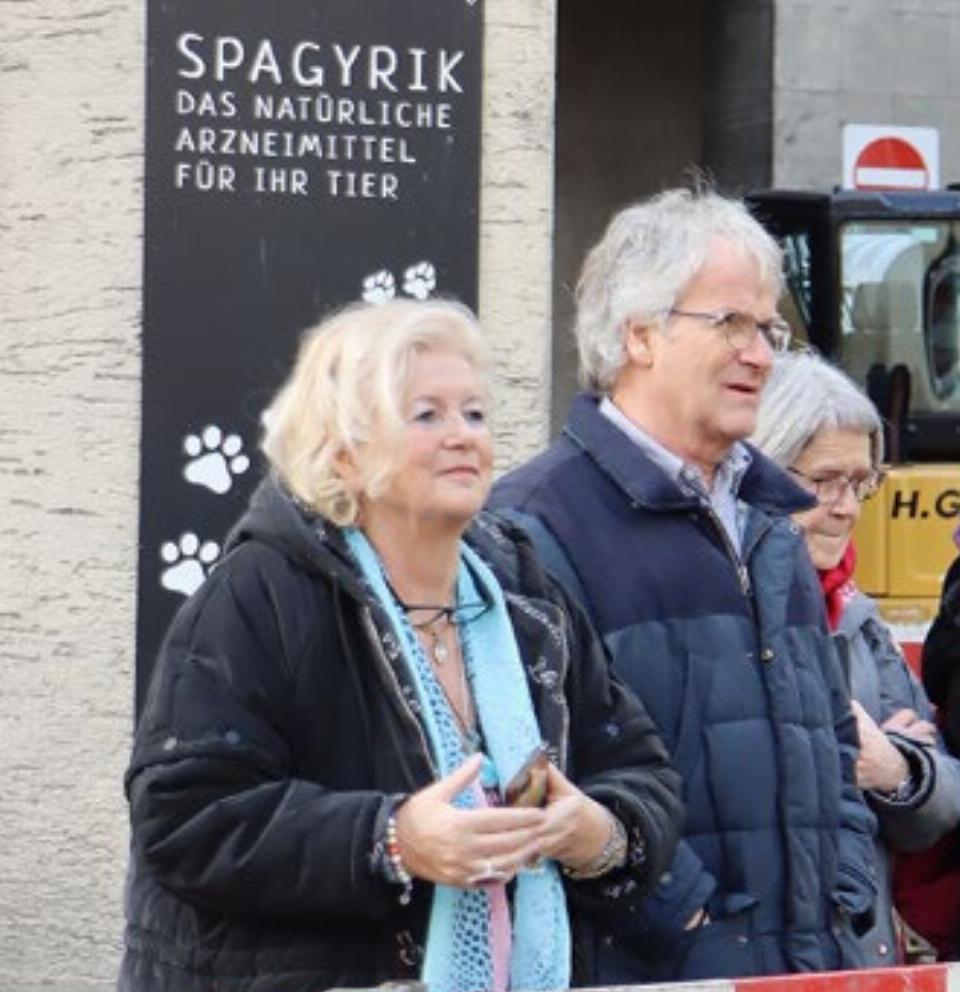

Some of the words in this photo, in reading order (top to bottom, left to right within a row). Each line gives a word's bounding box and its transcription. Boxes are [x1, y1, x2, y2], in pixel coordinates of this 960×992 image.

[177, 32, 464, 93] SPAGYRIK
[176, 89, 237, 117] DAS
[254, 93, 451, 129] NATÜRLICHE
[175, 127, 416, 163] ARZNEIMITTEL
[175, 160, 236, 191] FÜR
[254, 167, 308, 195] IHR
[327, 170, 398, 199] TIER
